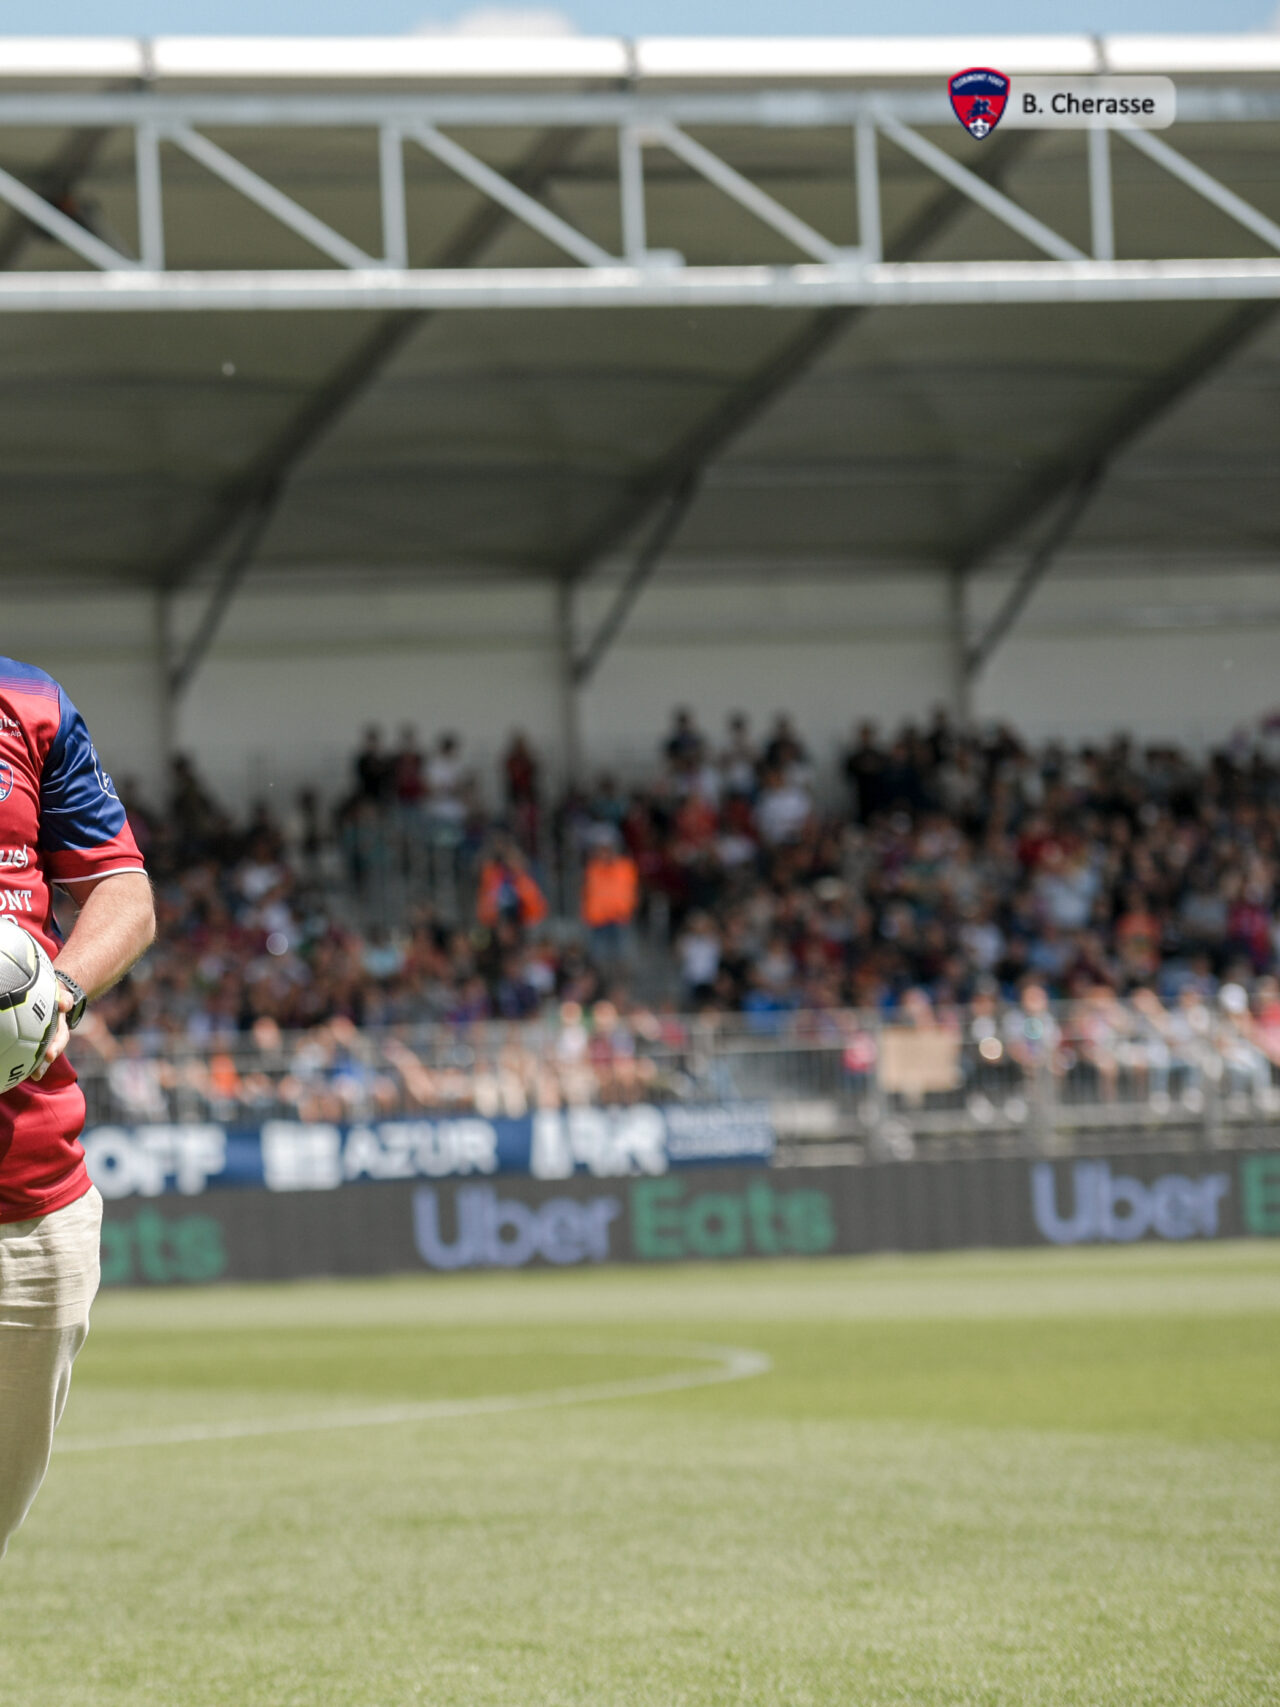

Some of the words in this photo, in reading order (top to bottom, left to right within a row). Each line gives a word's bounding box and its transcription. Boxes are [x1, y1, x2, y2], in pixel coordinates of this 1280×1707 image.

[342, 1115, 497, 1180] AZUR
[412, 1182, 617, 1271] Uber
[631, 1175, 837, 1262] Eats
[1031, 1158, 1230, 1245] Uber
